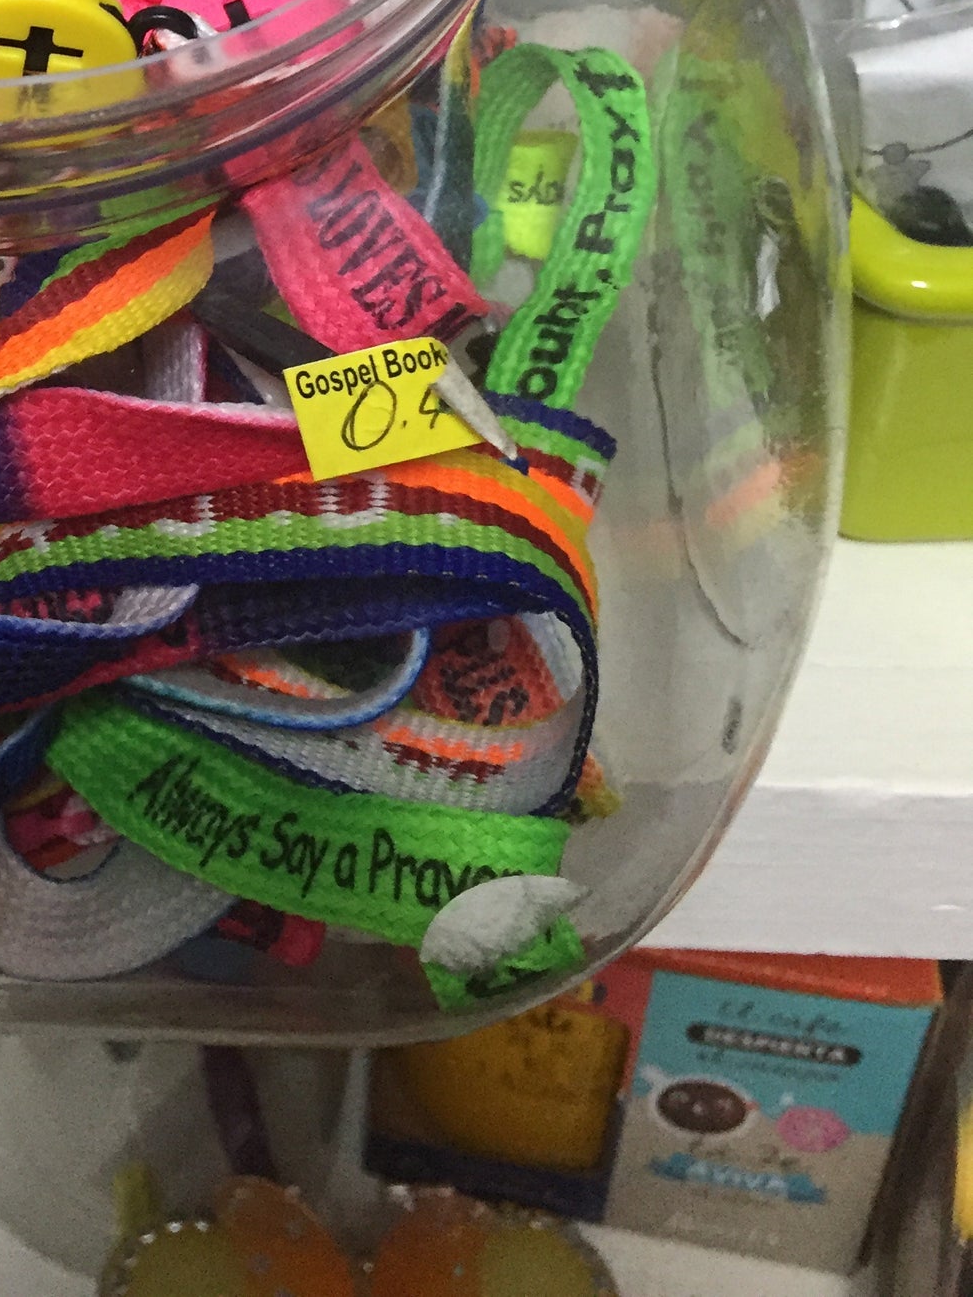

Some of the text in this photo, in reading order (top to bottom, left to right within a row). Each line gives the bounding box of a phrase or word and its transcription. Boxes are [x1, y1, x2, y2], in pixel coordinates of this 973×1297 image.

[295, 339, 448, 400] Gospel Book
[127, 750, 525, 908] Always Say a Pray
